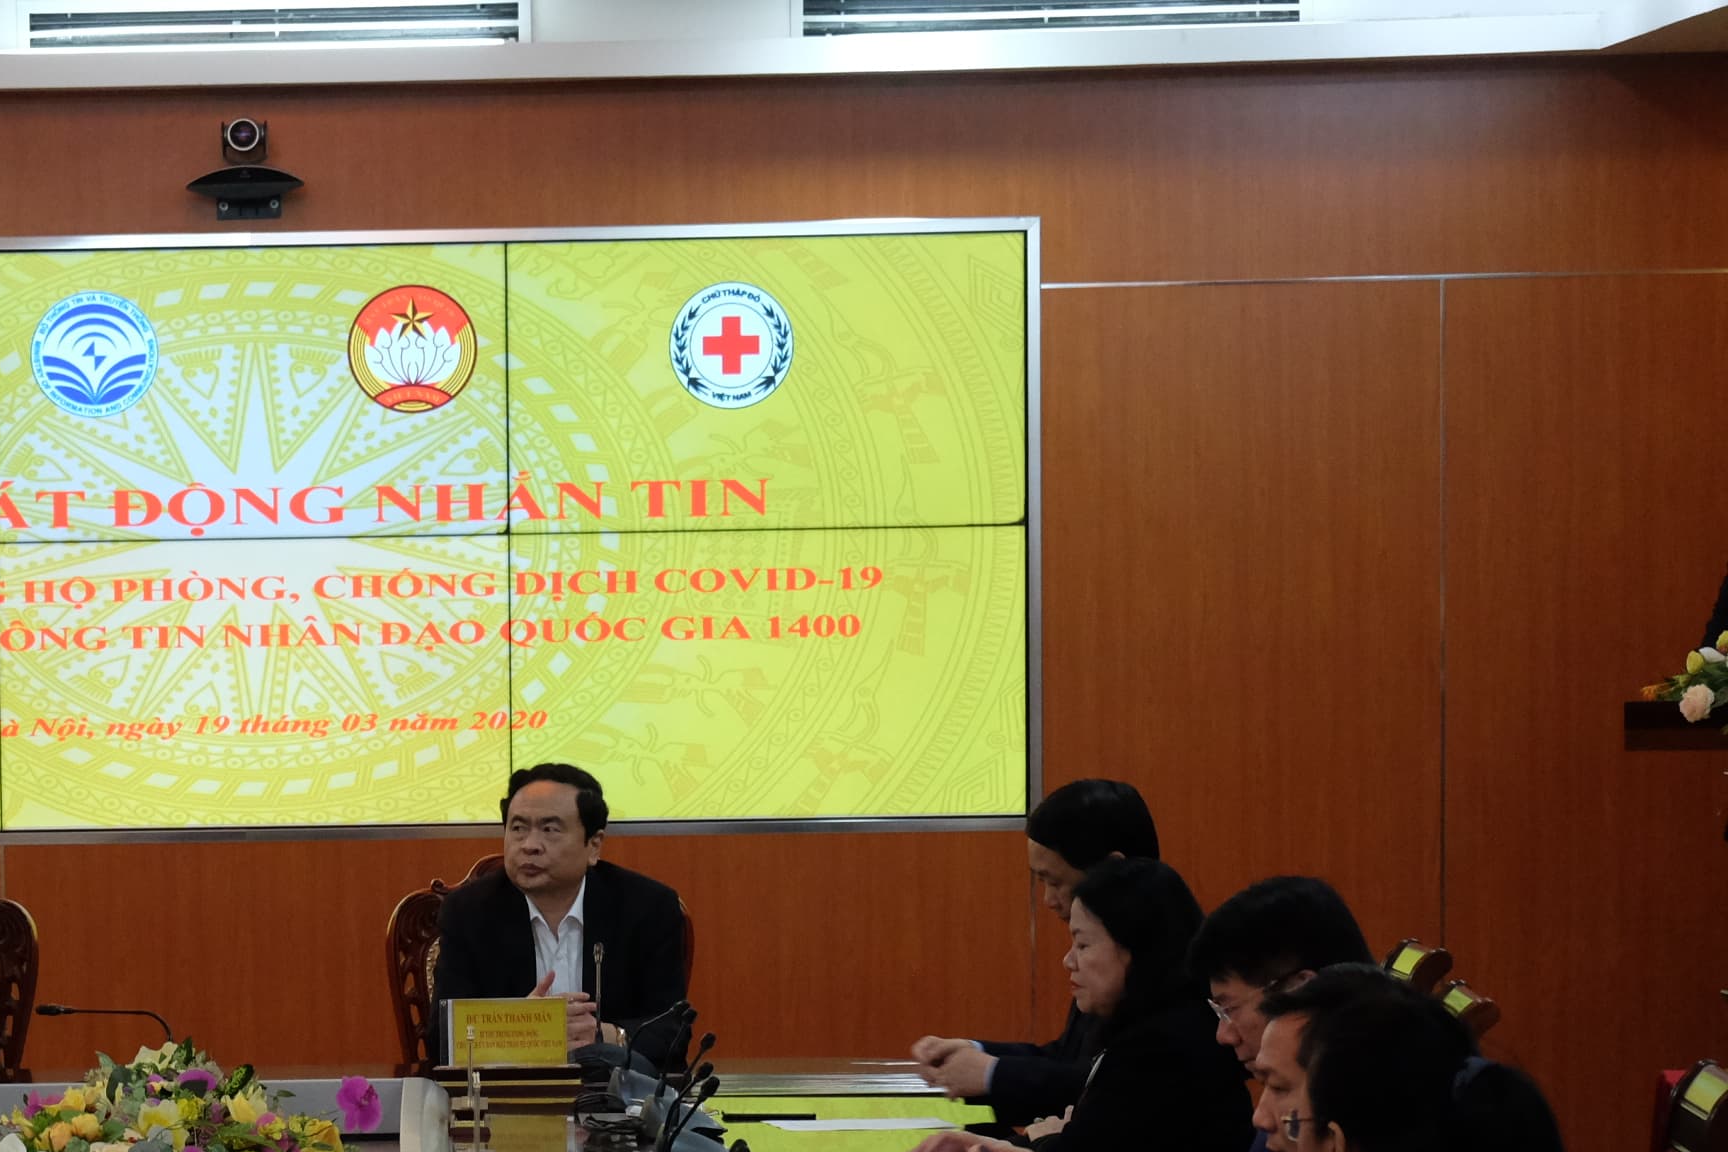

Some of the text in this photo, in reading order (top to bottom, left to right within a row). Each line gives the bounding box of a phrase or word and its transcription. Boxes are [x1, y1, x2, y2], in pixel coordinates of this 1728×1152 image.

[108, 482, 345, 537] ĐỘNG
[374, 471, 604, 523] NHẮN
[630, 477, 772, 518] TIN
[23, 575, 97, 610] HỘ
[112, 570, 300, 604] PHÒNG,
[515, 571, 638, 602] DỊCH
[654, 565, 884, 594] COVID-19
[121, 625, 205, 650] TIN
[223, 615, 361, 649] NHÂN
[378, 619, 487, 652] ĐẠO
[660, 615, 752, 641] GIA
[768, 613, 862, 640] 1400
[30, 717, 95, 742] Nội,
[105, 717, 184, 741] ngày
[195, 714, 232, 735] 19
[239, 713, 331, 738] tháng
[341, 713, 379, 732] 03
[389, 713, 459, 732] năm
[469, 709, 548, 732] 2020
